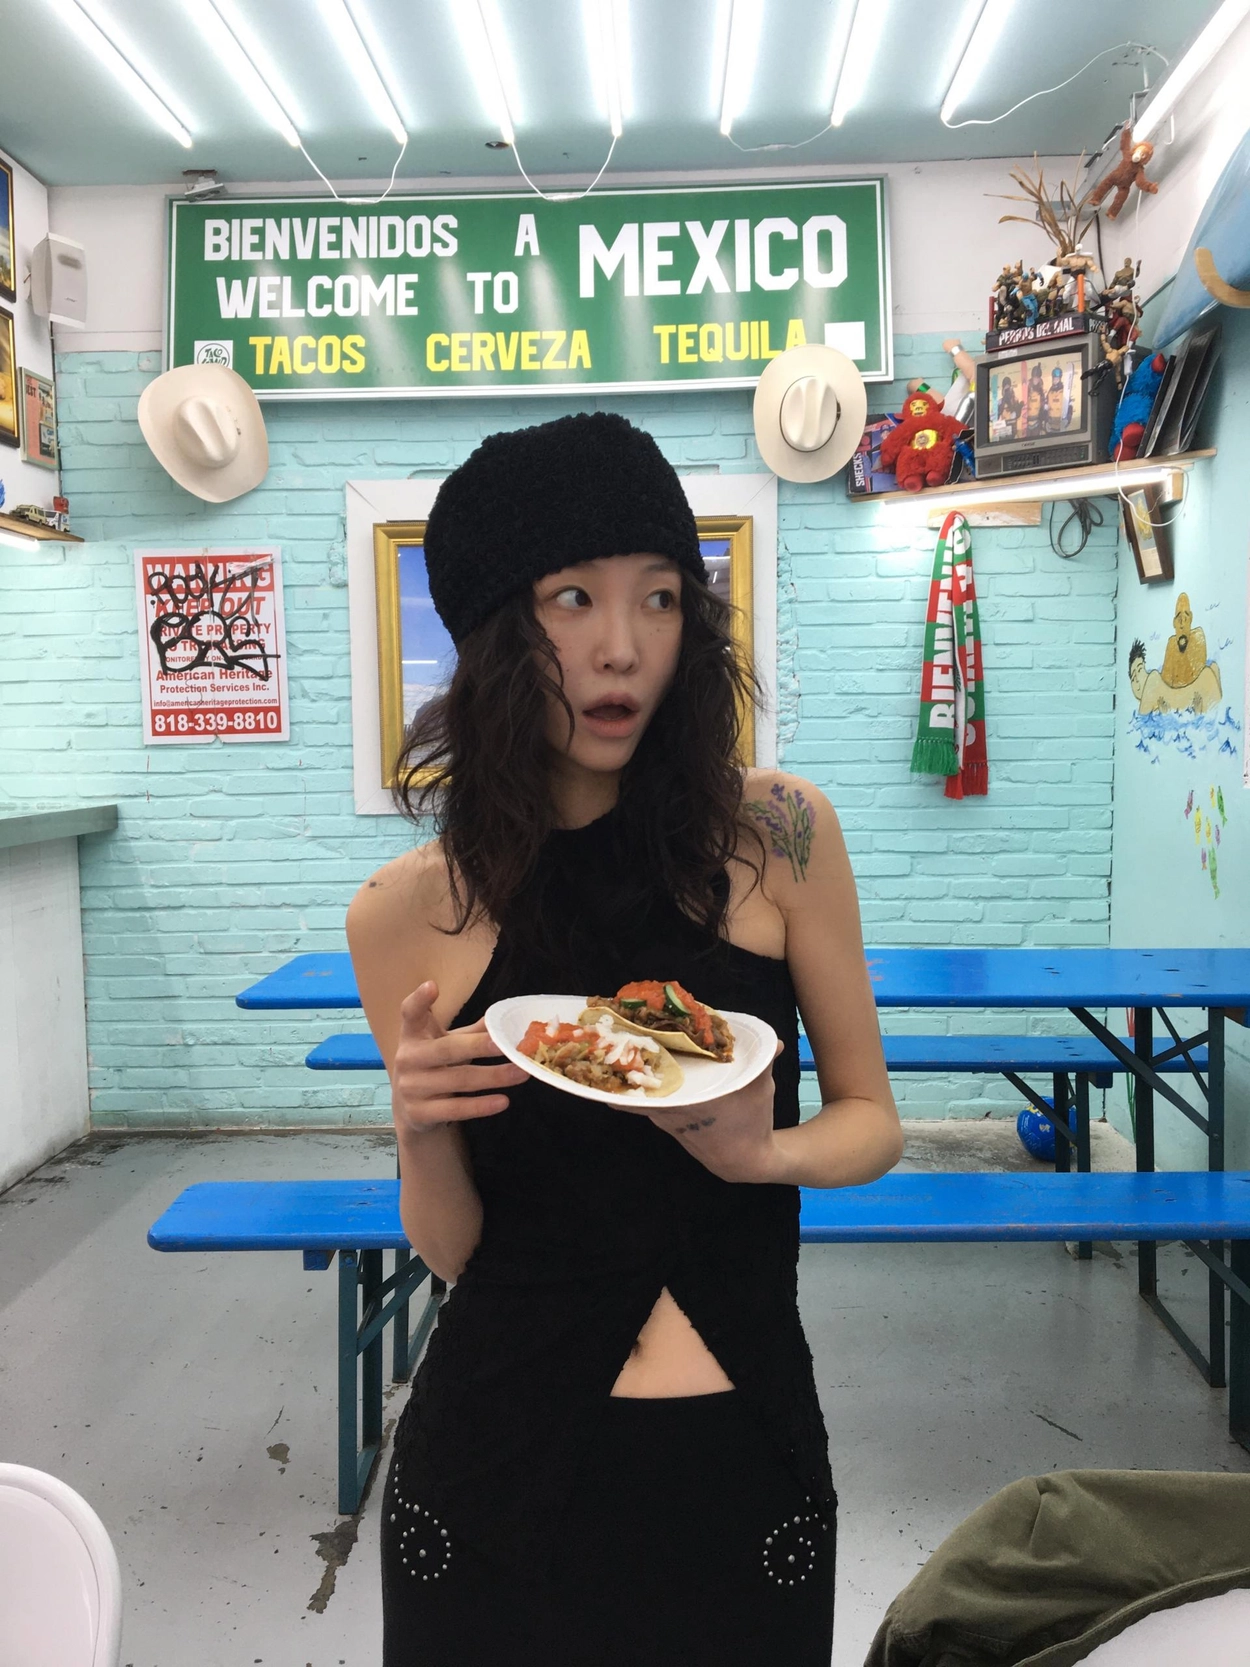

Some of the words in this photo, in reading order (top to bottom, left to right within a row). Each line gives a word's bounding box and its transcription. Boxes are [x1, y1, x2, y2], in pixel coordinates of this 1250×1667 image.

[204, 214, 458, 261] BIENVENIDOS
[514, 213, 541, 257] A
[579, 214, 849, 298] MEXICO
[216, 273, 419, 319] WELCOME
[467, 271, 519, 314] TO
[249, 334, 366, 375] TACOS
[426, 329, 592, 373] CERVEZA
[653, 318, 808, 364] TEQUILA
[221, 596, 266, 617] OUT
[206, 623, 271, 636] PRPERTY
[161, 655, 198, 663] ONITORE
[156, 670, 215, 681] American
[160, 683, 208, 694] Protection
[210, 682, 250, 692] Services
[252, 680, 270, 691] Inc.
[154, 711, 278, 732] 818-339-8810
